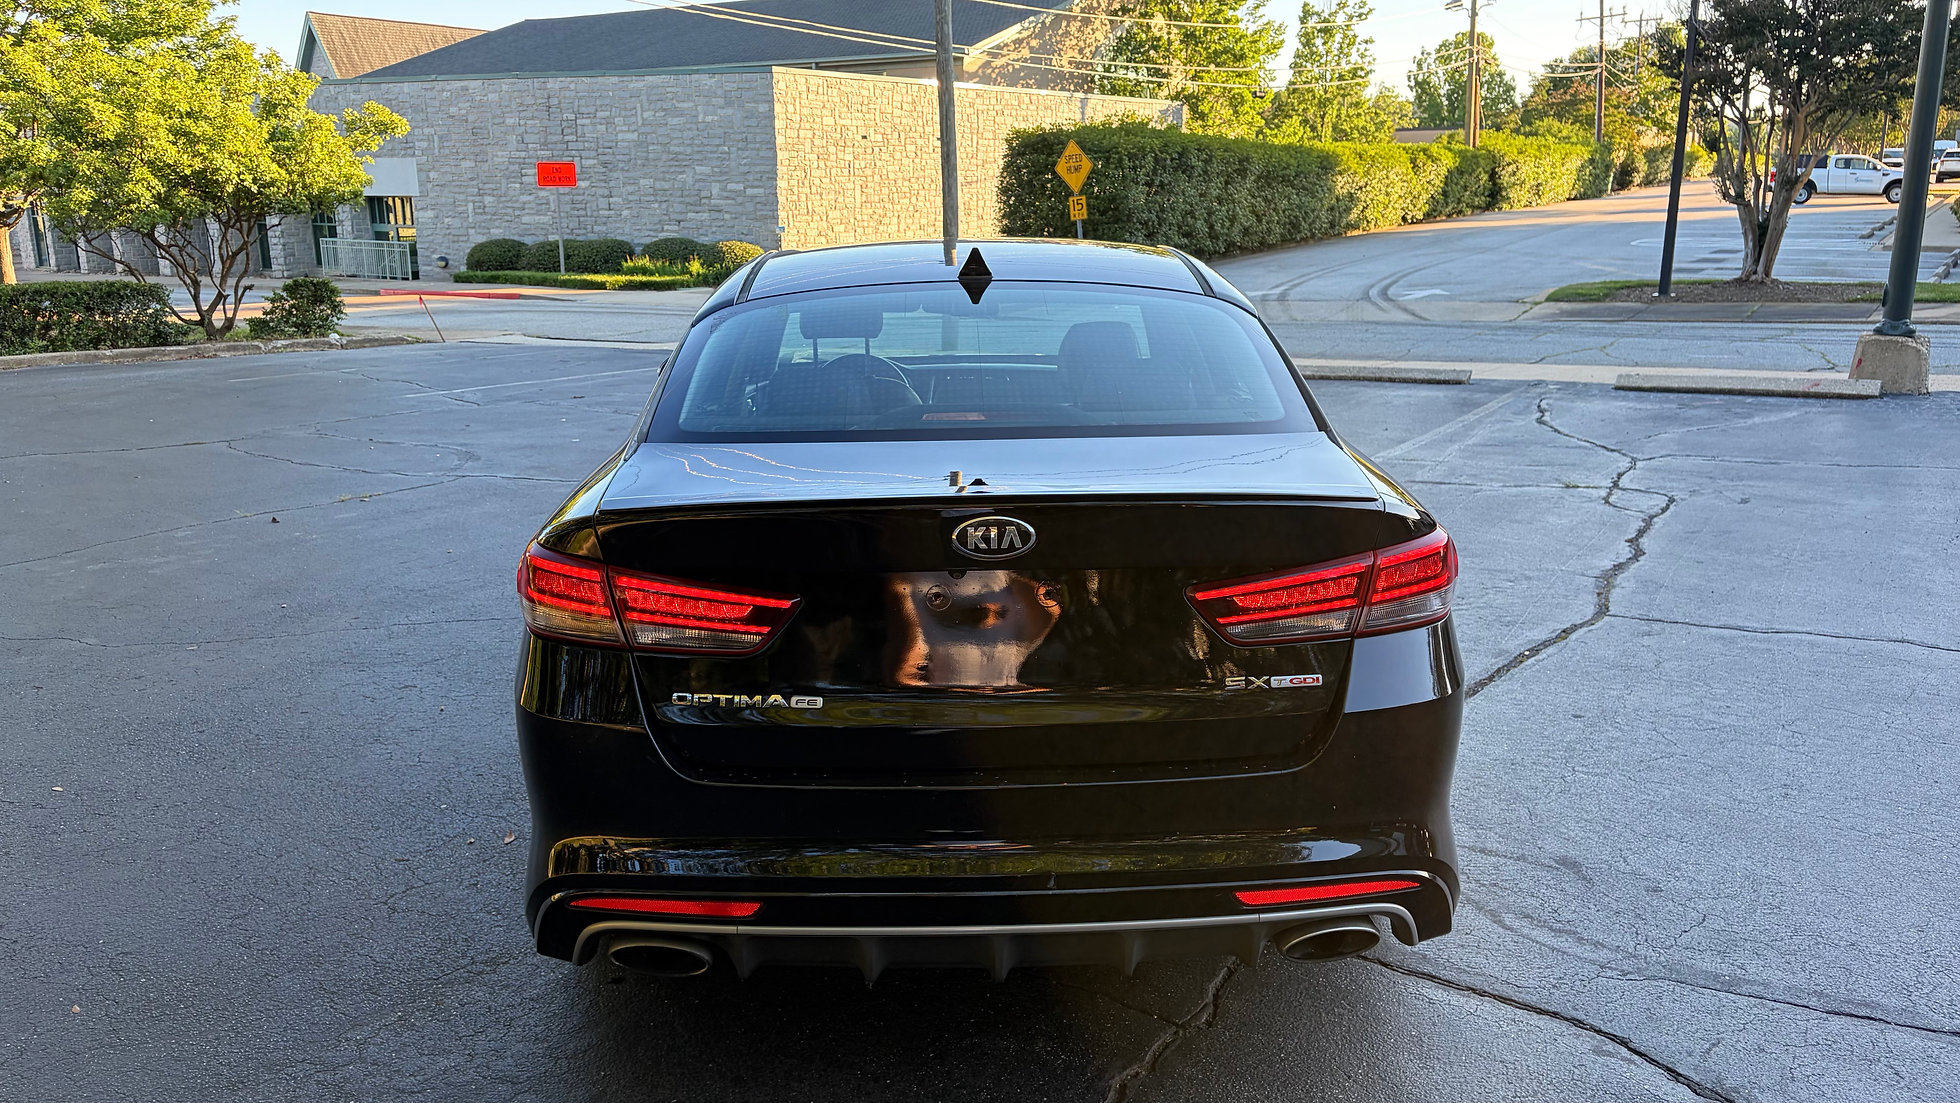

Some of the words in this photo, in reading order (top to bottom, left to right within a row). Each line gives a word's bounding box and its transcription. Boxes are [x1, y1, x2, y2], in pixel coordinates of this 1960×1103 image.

[1064, 153, 1083, 164] SPEED
[1066, 164, 1083, 175] HUMP
[1071, 198, 1084, 212] 15
[966, 525, 1023, 549] KIA
[1224, 675, 1270, 690] SX
[671, 692, 789, 708] OPTIMA
